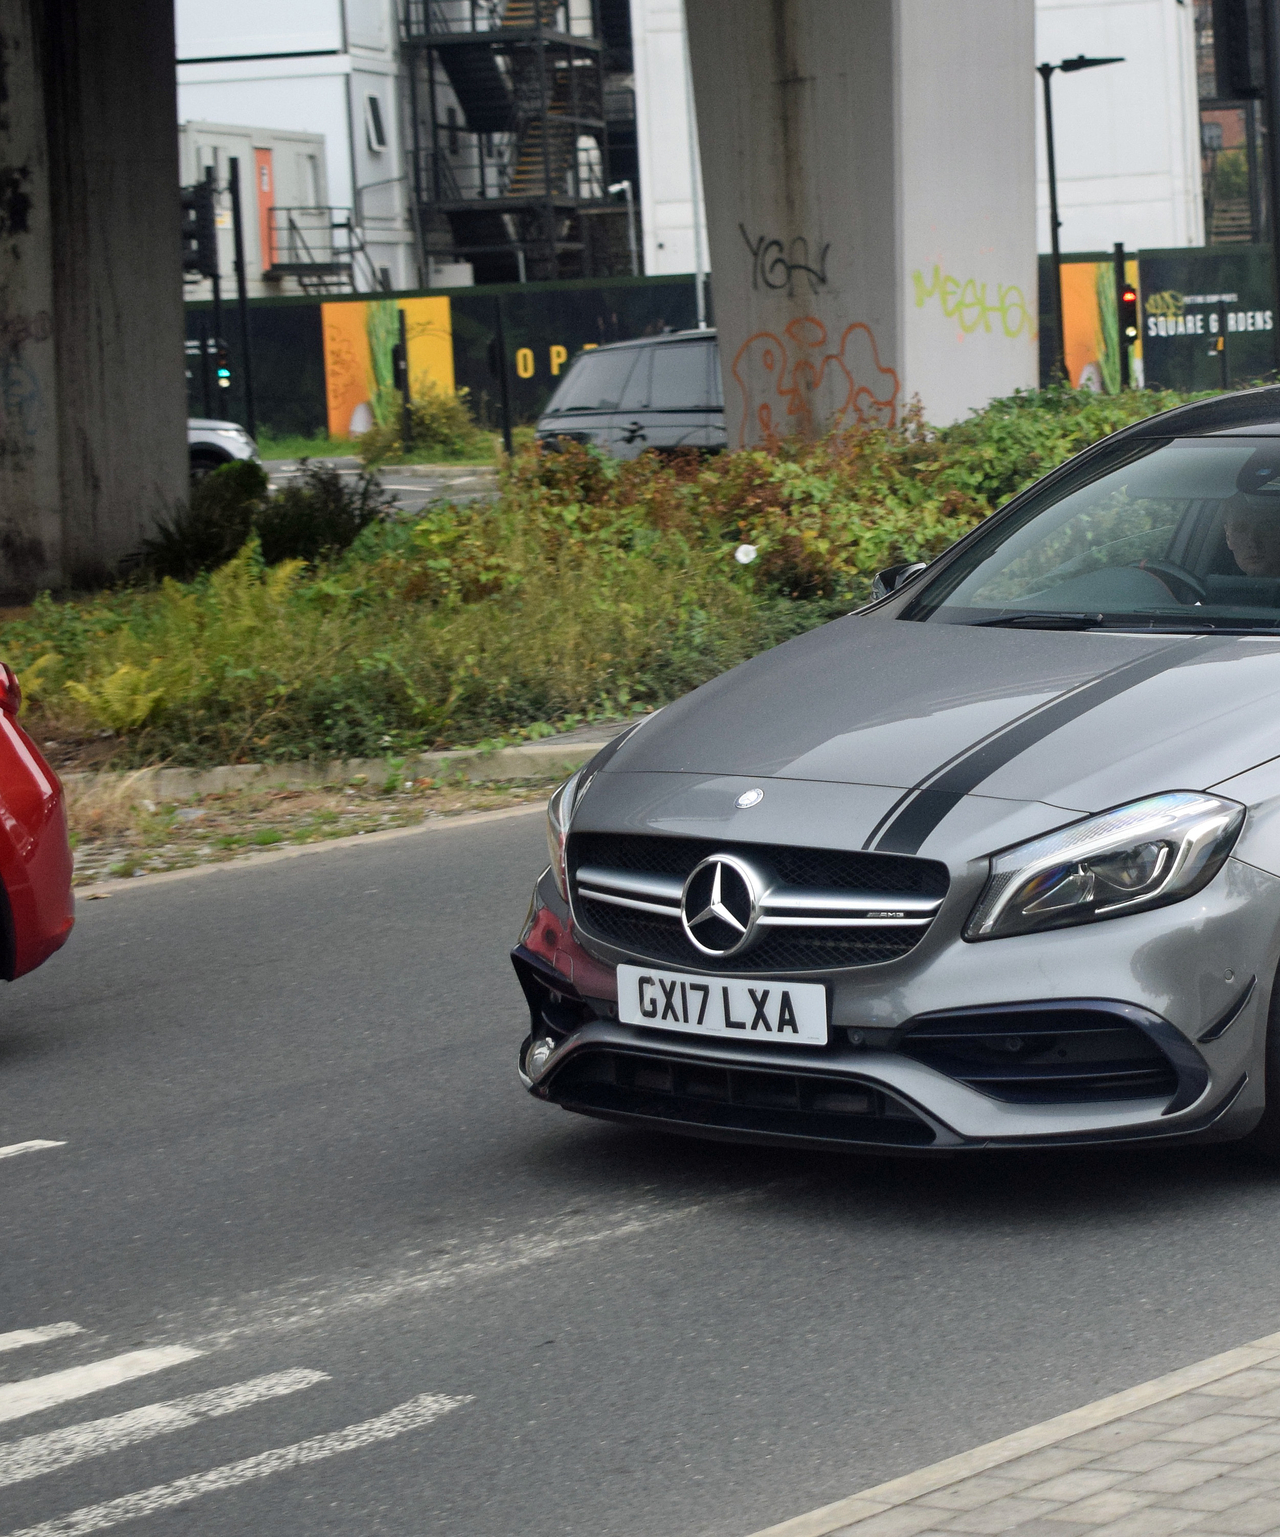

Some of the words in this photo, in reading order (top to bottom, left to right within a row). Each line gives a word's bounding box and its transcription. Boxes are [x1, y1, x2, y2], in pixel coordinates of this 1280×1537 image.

[1147, 314, 1204, 337] SQUARE
[1209, 310, 1273, 333] GRDENS
[515, 343, 599, 379] OP
[638, 975, 709, 1026] GX17
[721, 985, 799, 1034] LXA
